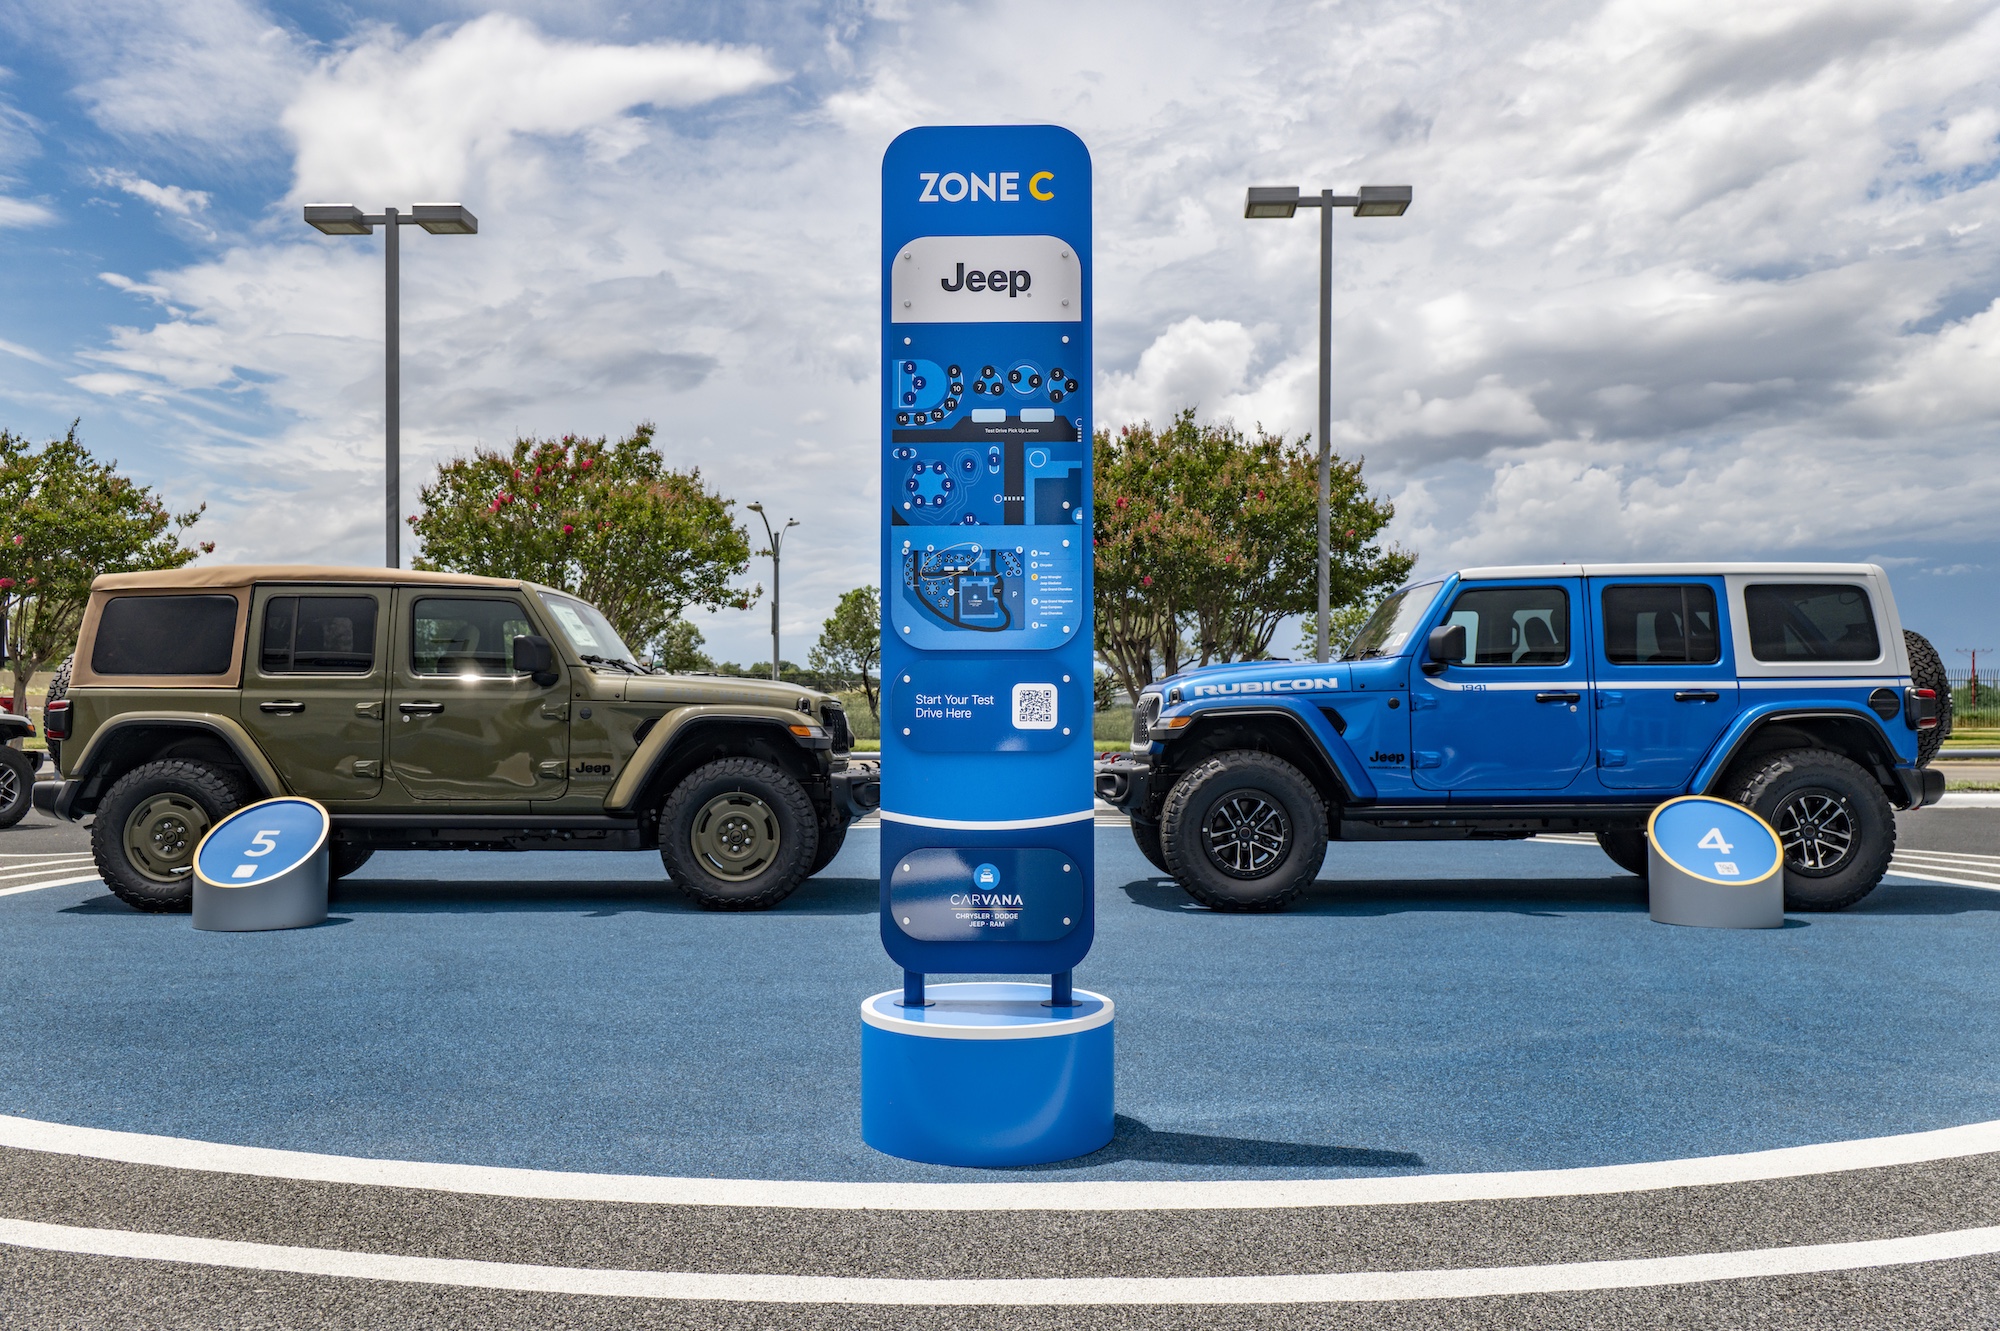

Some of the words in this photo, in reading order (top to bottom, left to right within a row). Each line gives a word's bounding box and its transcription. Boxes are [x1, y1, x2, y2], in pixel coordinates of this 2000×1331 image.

[919, 172, 1019, 202] ZONE
[1028, 171, 1055, 201] C
[941, 263, 1031, 297] Jeep
[1194, 678, 1338, 696] RUBICON
[916, 694, 941, 704] Start
[945, 695, 968, 704] Your
[972, 695, 994, 705] Test
[916, 708, 942, 718] Drive
[946, 708, 971, 718] Here
[1370, 751, 1404, 764] Jeep
[576, 762, 610, 775] Jeep
[244, 830, 280, 856] 5
[1698, 828, 1733, 854] 4
[950, 894, 1023, 905] CARVANA
